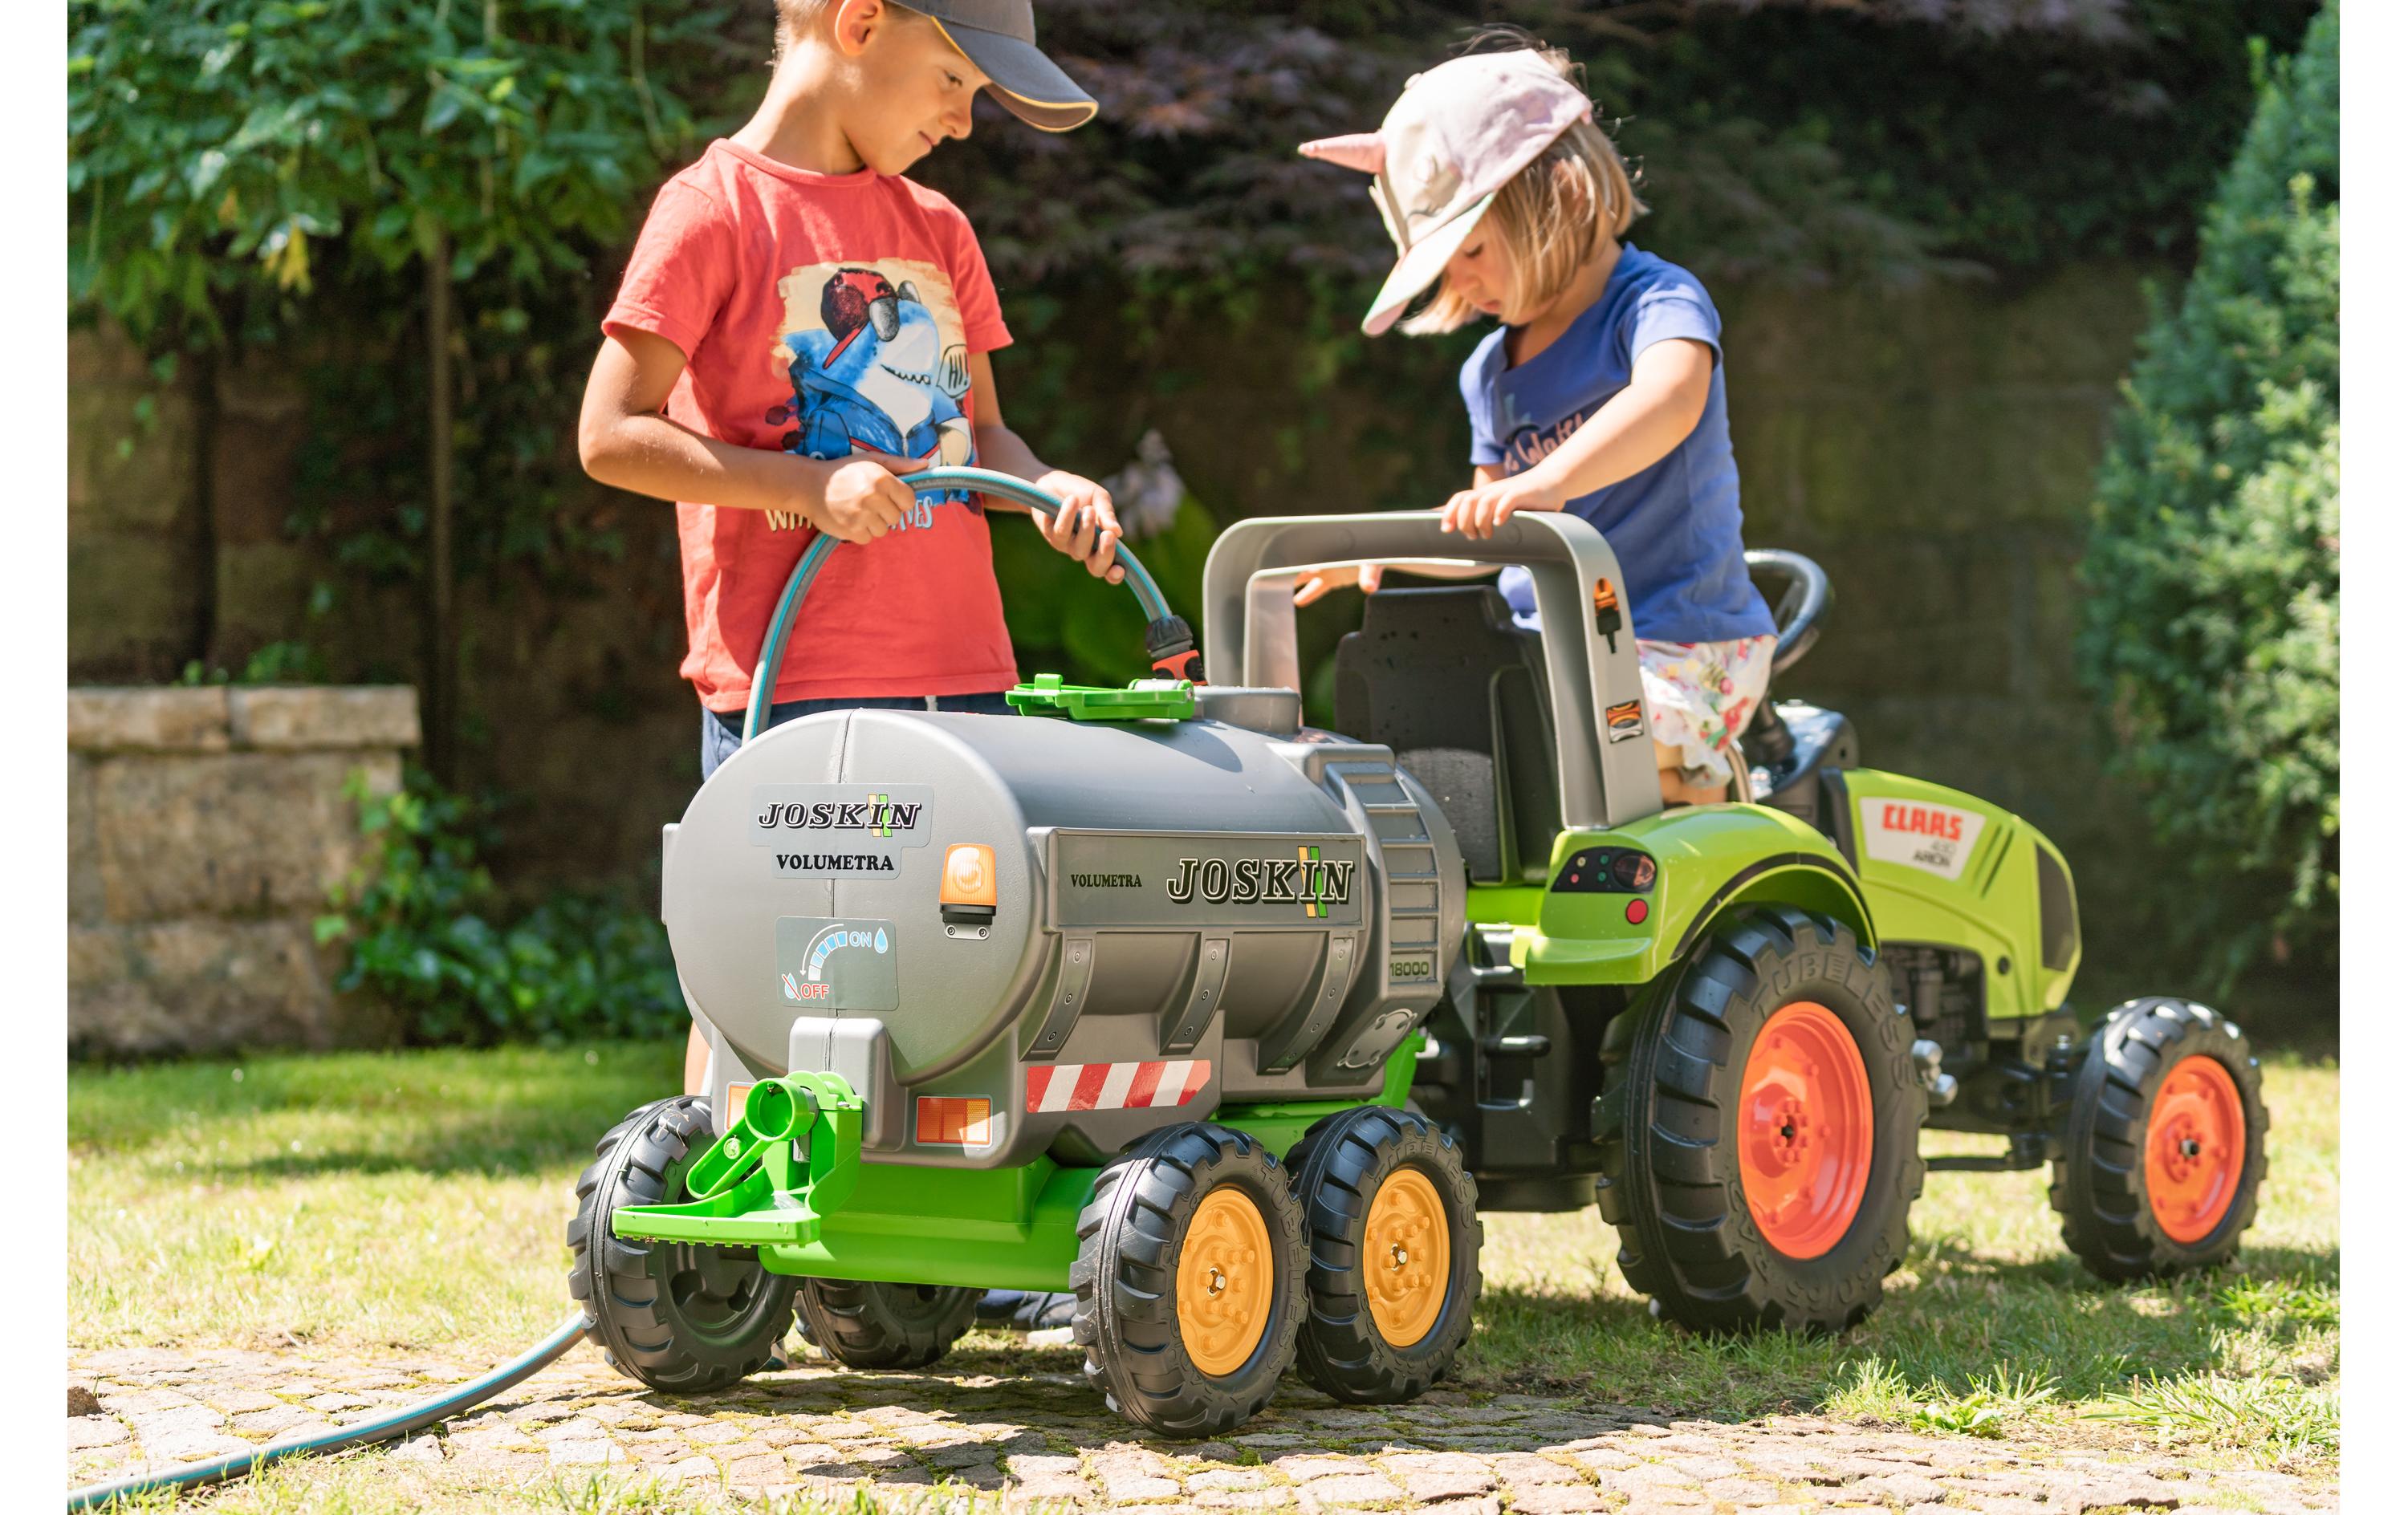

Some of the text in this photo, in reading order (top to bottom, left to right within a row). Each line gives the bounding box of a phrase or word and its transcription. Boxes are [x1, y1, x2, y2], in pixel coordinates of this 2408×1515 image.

[758, 802, 922, 829] JOSKIN
[1881, 803, 1963, 842] CLAAS
[776, 855, 894, 871] VOLUMETRA
[1071, 857, 1356, 905] VOLUMETRA JOSKIN
[848, 931, 872, 948] ON
[1389, 961, 1430, 977] 18000
[800, 983, 830, 1000] OFF
[1749, 952, 1914, 1091] TUBELESS
[1259, 1167, 1303, 1376] TUBELESS
